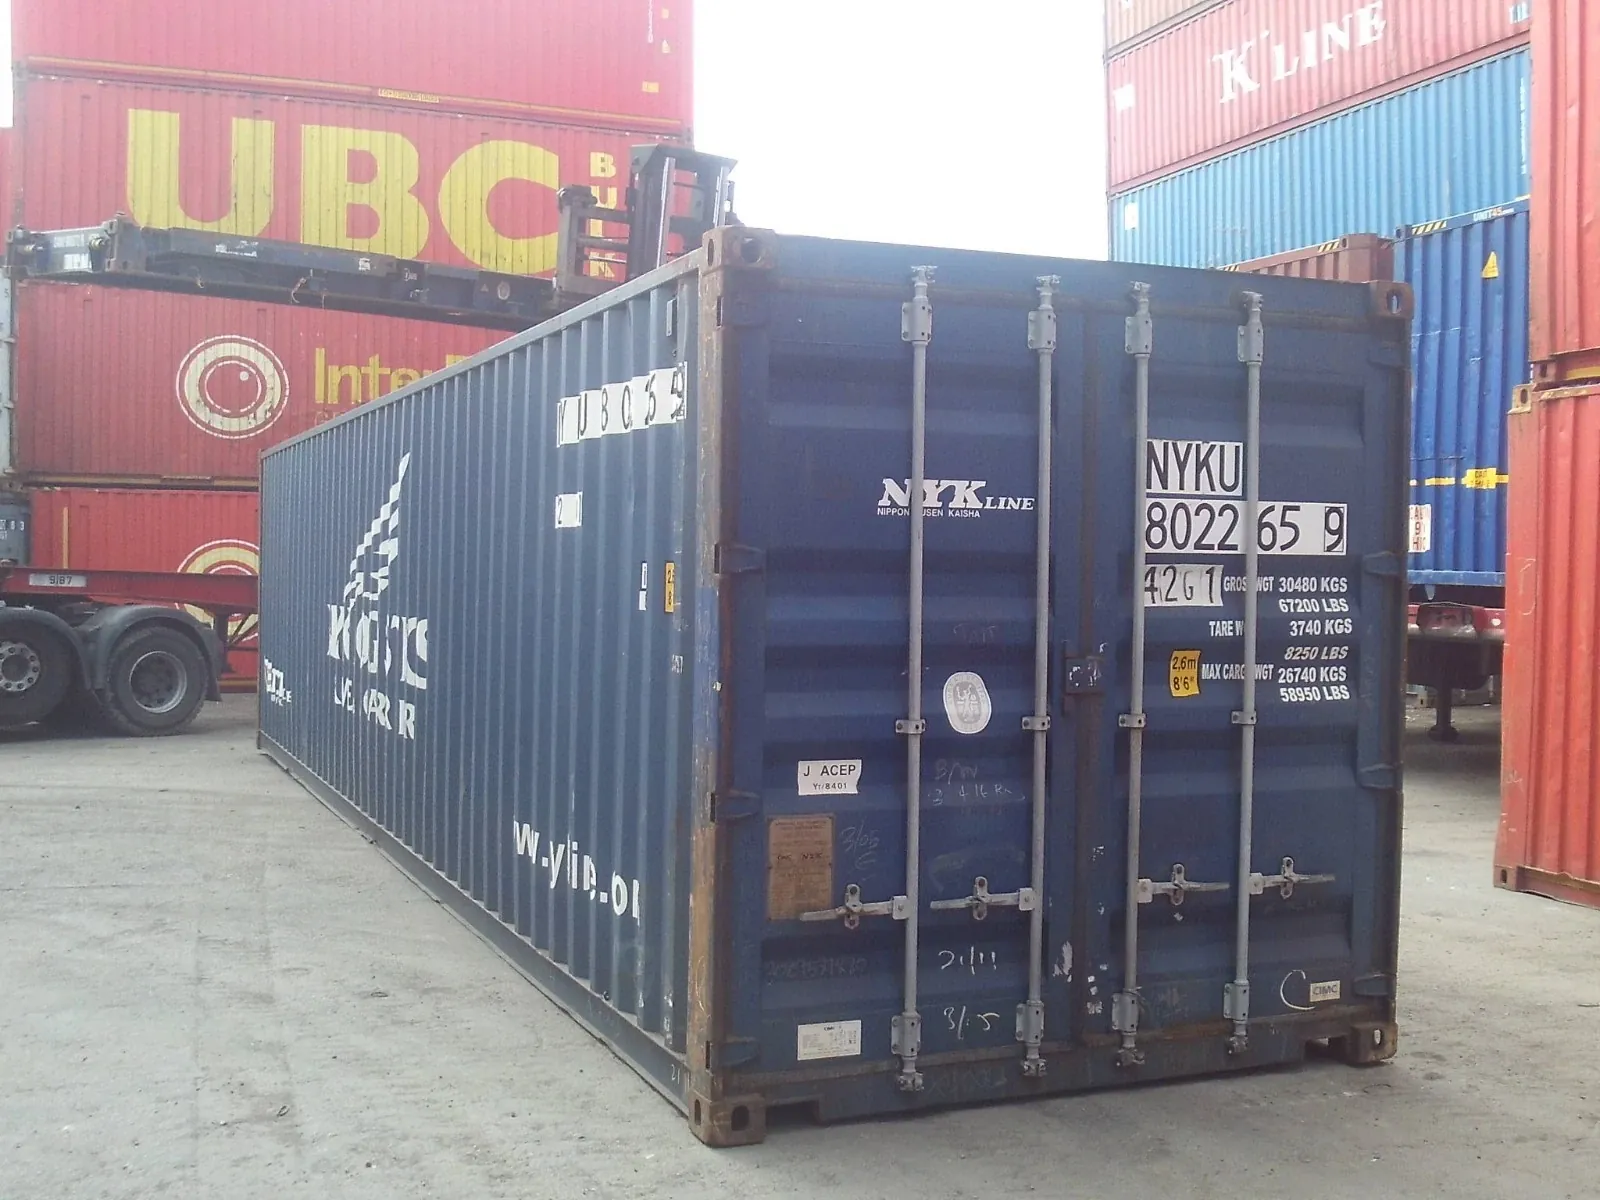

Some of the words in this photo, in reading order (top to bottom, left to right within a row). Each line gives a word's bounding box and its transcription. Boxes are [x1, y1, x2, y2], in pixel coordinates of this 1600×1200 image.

[1273, 1, 1387, 81] LINE
[127, 108, 559, 275] UBC
[315, 348, 433, 404] Inte
[1147, 441, 1241, 492] NYKU
[878, 478, 986, 508] NYK
[984, 496, 1035, 510] LINE
[877, 508, 909, 517] NIPPON
[922, 509, 944, 517] USEN
[948, 510, 980, 518] KAISHA
[1325, 506, 1344, 552] 9
[1224, 576, 1247, 592] GROS
[1279, 576, 1317, 593] 30480
[1320, 576, 1348, 593] KGS
[1279, 599, 1320, 613] 67200
[1324, 597, 1349, 612] LBS
[1209, 620, 1234, 637] TARE
[1290, 619, 1321, 636] 3740
[1325, 617, 1353, 635] KGS
[1285, 646, 1317, 660] 8250
[1320, 645, 1349, 660] LBS
[1202, 663, 1221, 680] MAX
[1222, 664, 1245, 680] CARG
[1278, 667, 1316, 683] 26740
[1320, 666, 1347, 682] KGS
[1279, 687, 1321, 702] 58950
[1325, 685, 1350, 700] LBS
[820, 765, 856, 776] ACEP
